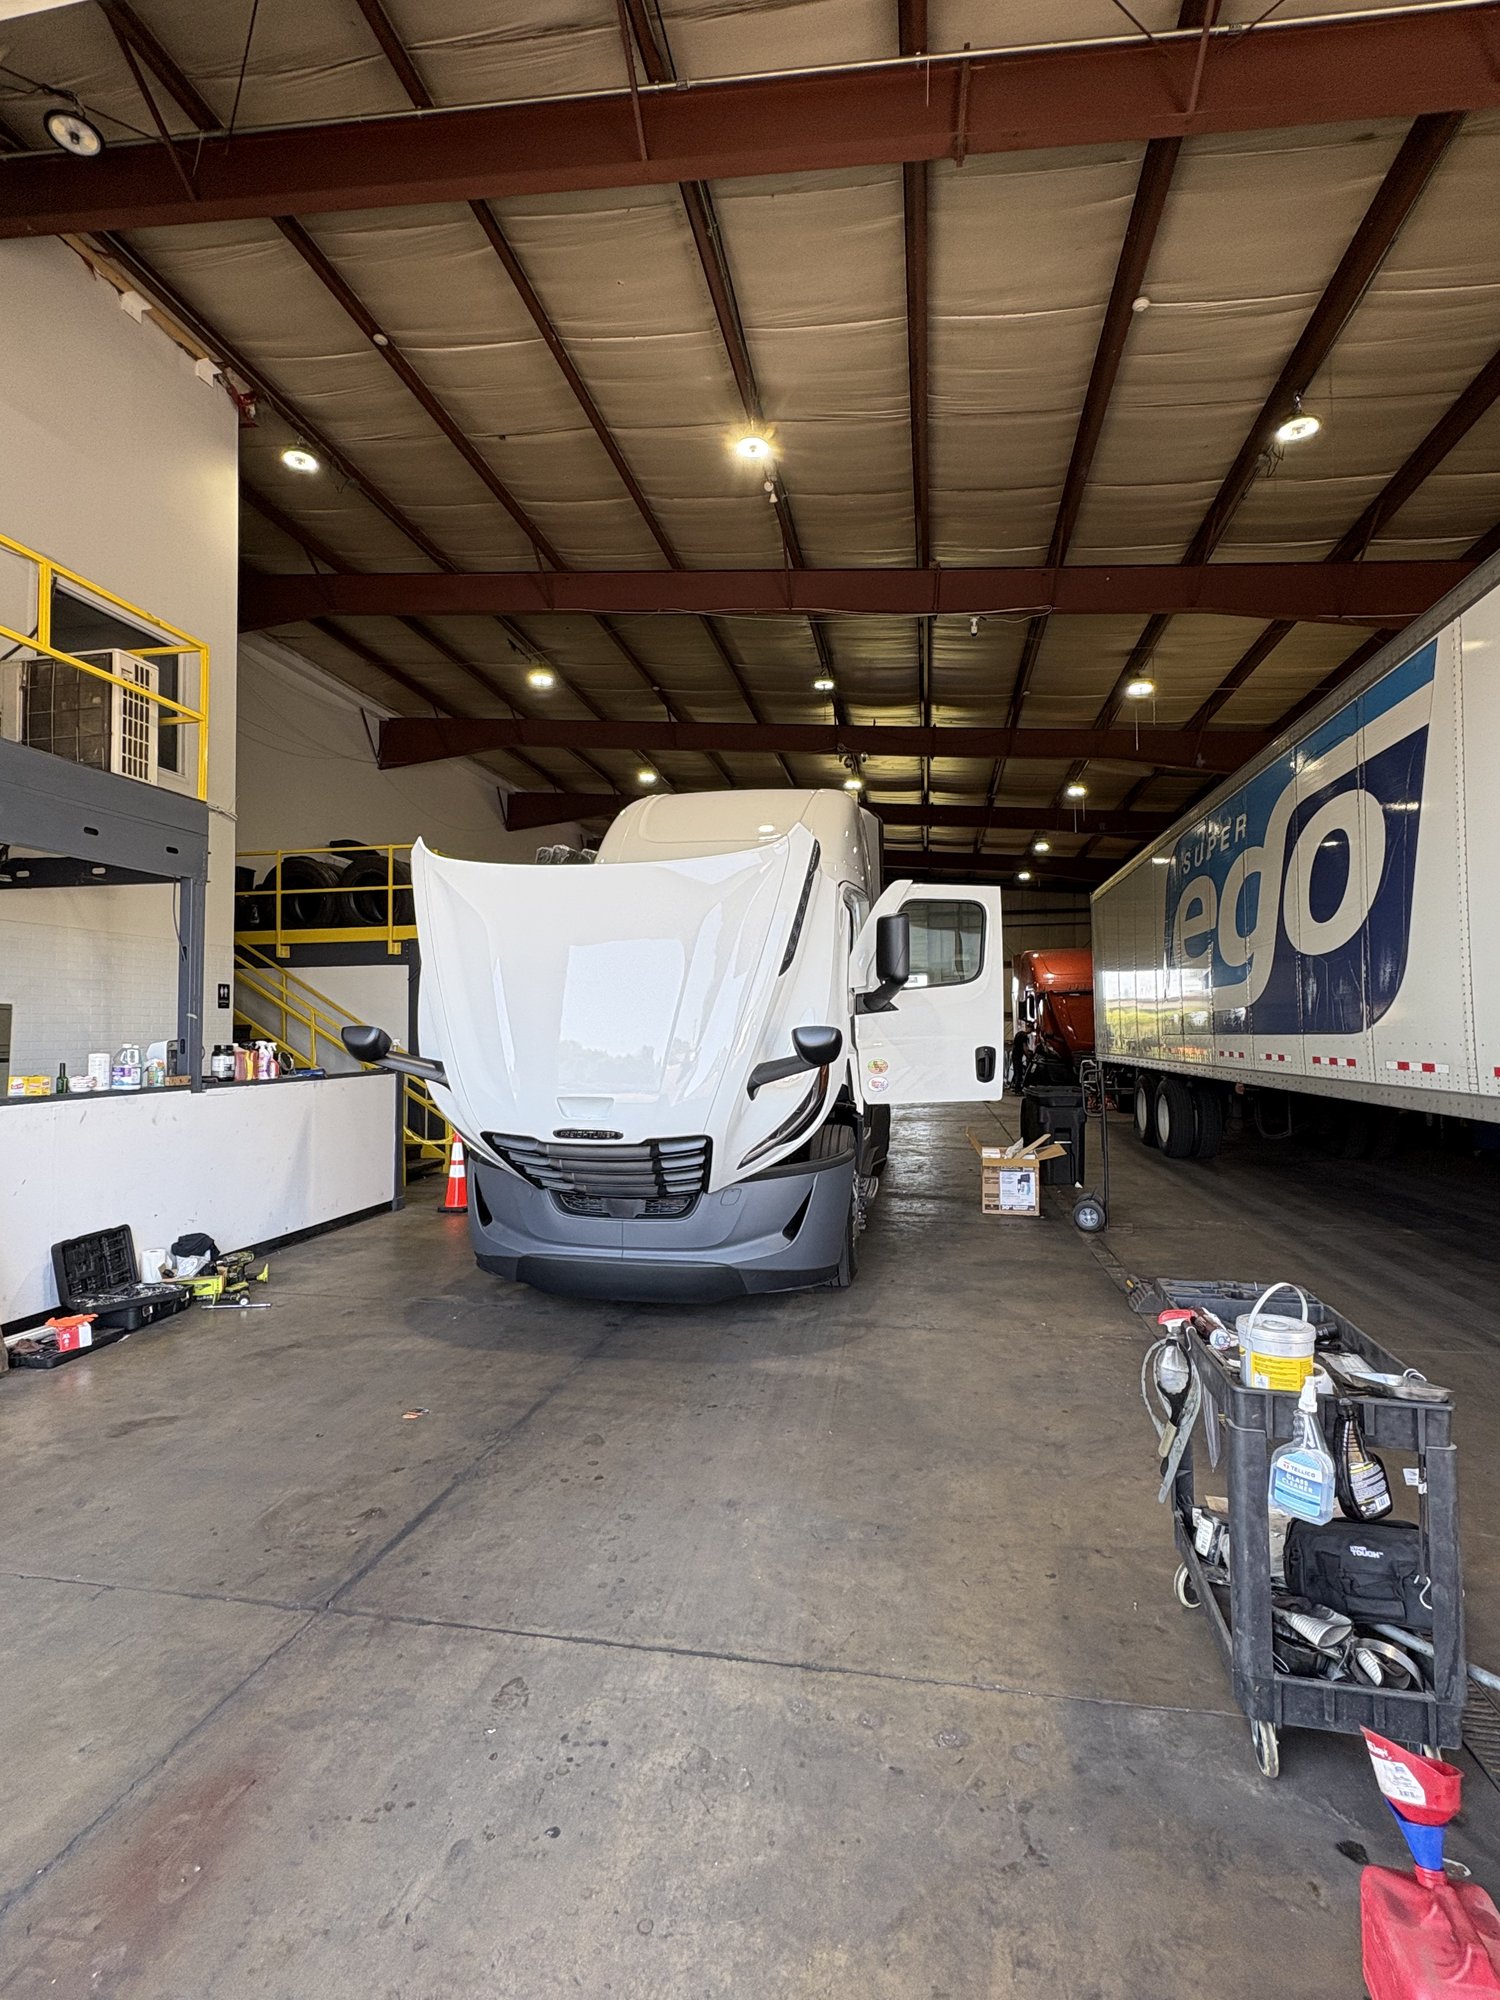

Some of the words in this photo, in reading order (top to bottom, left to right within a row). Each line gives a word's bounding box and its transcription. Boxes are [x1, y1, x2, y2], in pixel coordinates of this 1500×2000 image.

[1182, 813, 1248, 875] SUPER
[1172, 787, 1386, 1011] ego
[560, 1130, 616, 1139] FREIGHTLINER
[1290, 1465, 1317, 1479] TELLICO
[1281, 1477, 1314, 1494] CLEANER
[1286, 1473, 1310, 1487] GLASS
